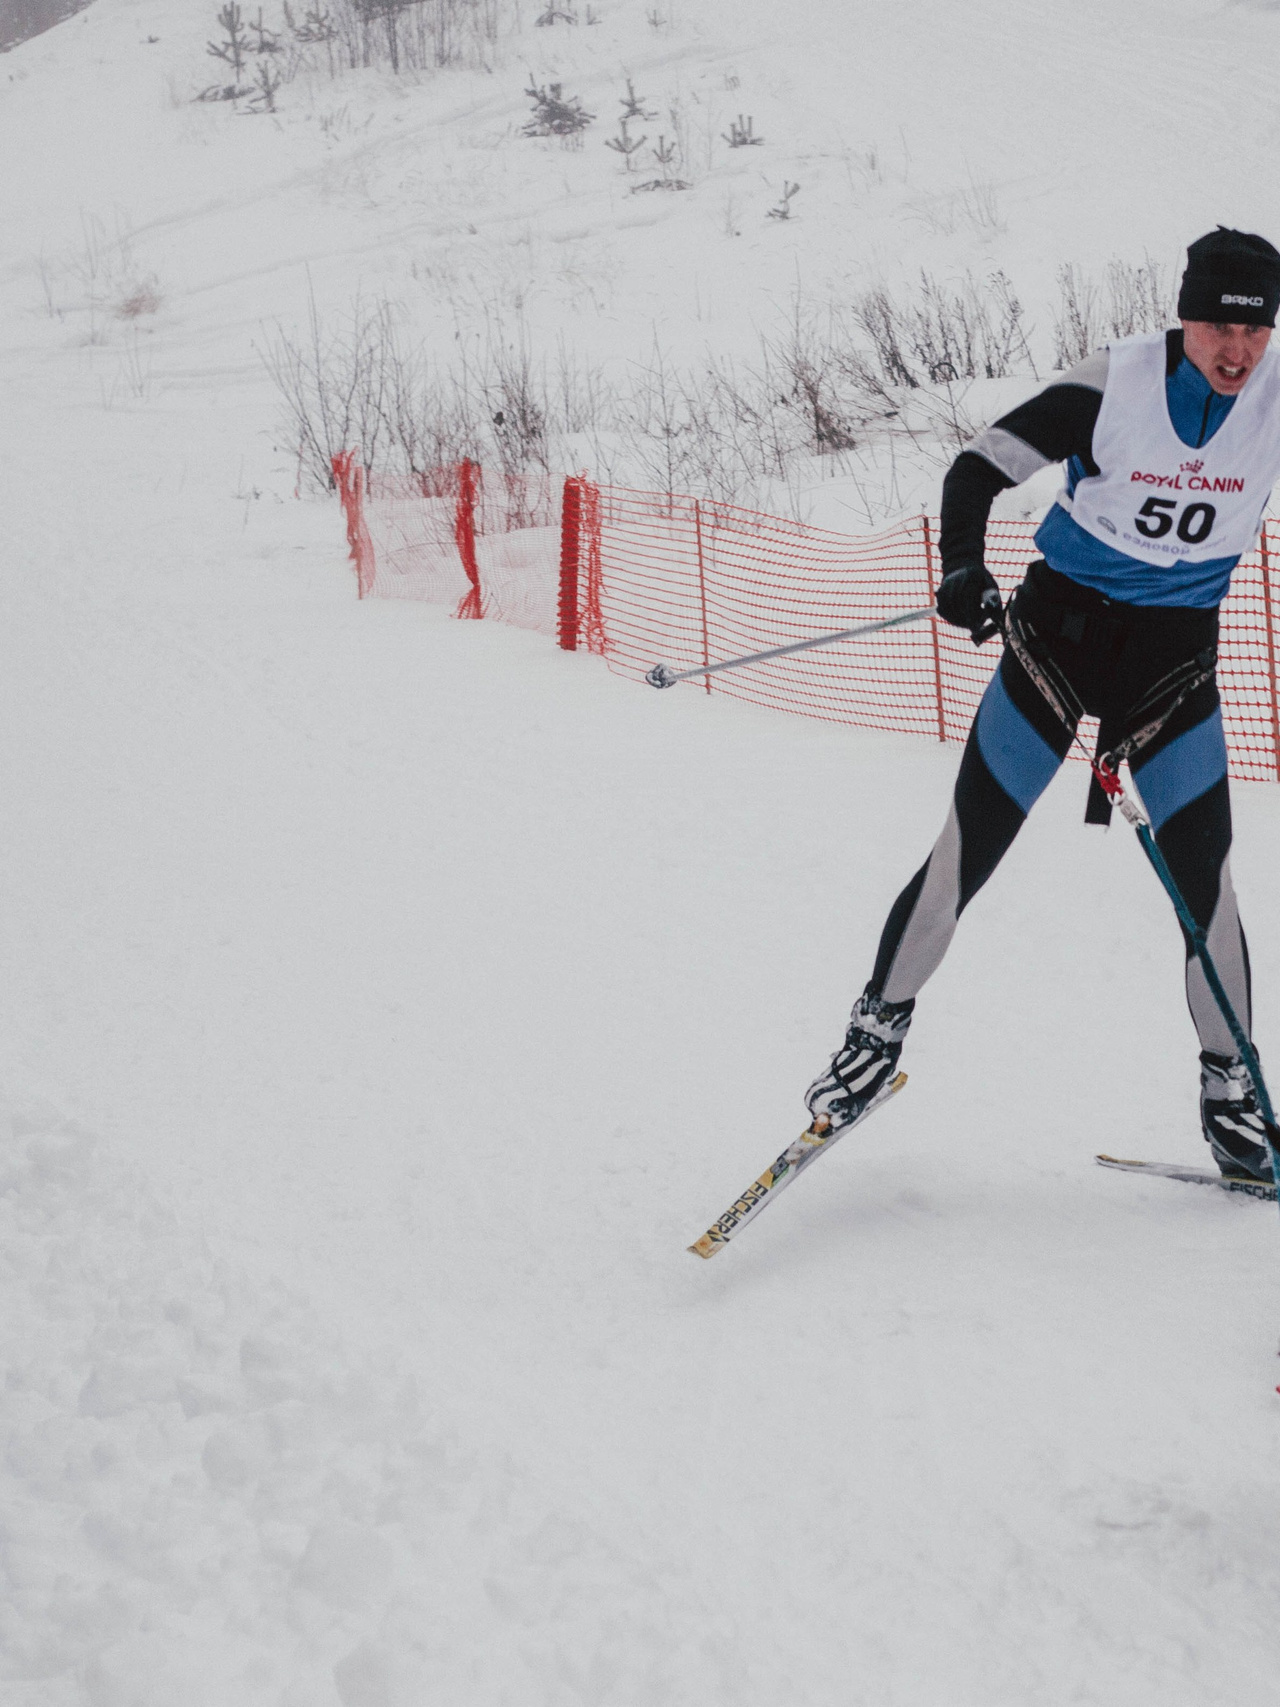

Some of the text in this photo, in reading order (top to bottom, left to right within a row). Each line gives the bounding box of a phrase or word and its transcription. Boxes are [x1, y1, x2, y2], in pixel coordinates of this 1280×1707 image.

[1188, 476, 1245, 493] CANIN
[1134, 497, 1216, 544] 50
[713, 1181, 768, 1234] FISCHER
